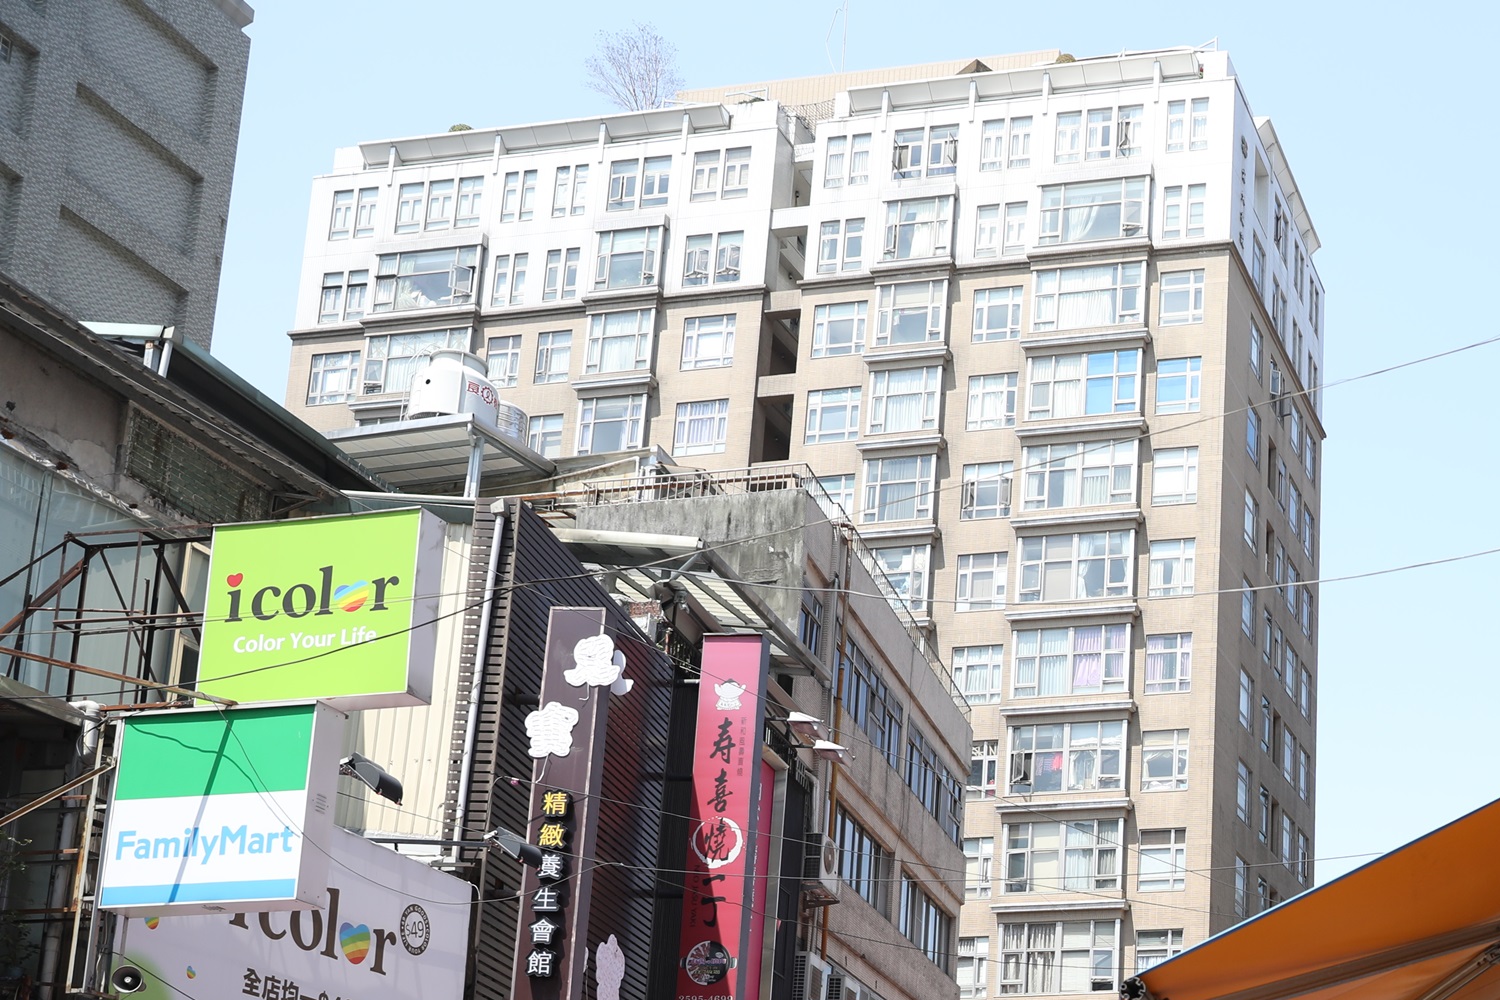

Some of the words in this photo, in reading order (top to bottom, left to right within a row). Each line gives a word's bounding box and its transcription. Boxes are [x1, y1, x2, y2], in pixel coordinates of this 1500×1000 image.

[225, 565, 400, 623] icolor
[233, 631, 285, 654] Color
[289, 630, 336, 652] Your
[340, 626, 377, 646] Life
[116, 824, 293, 865] FamilyMart
[527, 791, 569, 978] 精緻養生會館
[405, 920, 425, 939] $49
